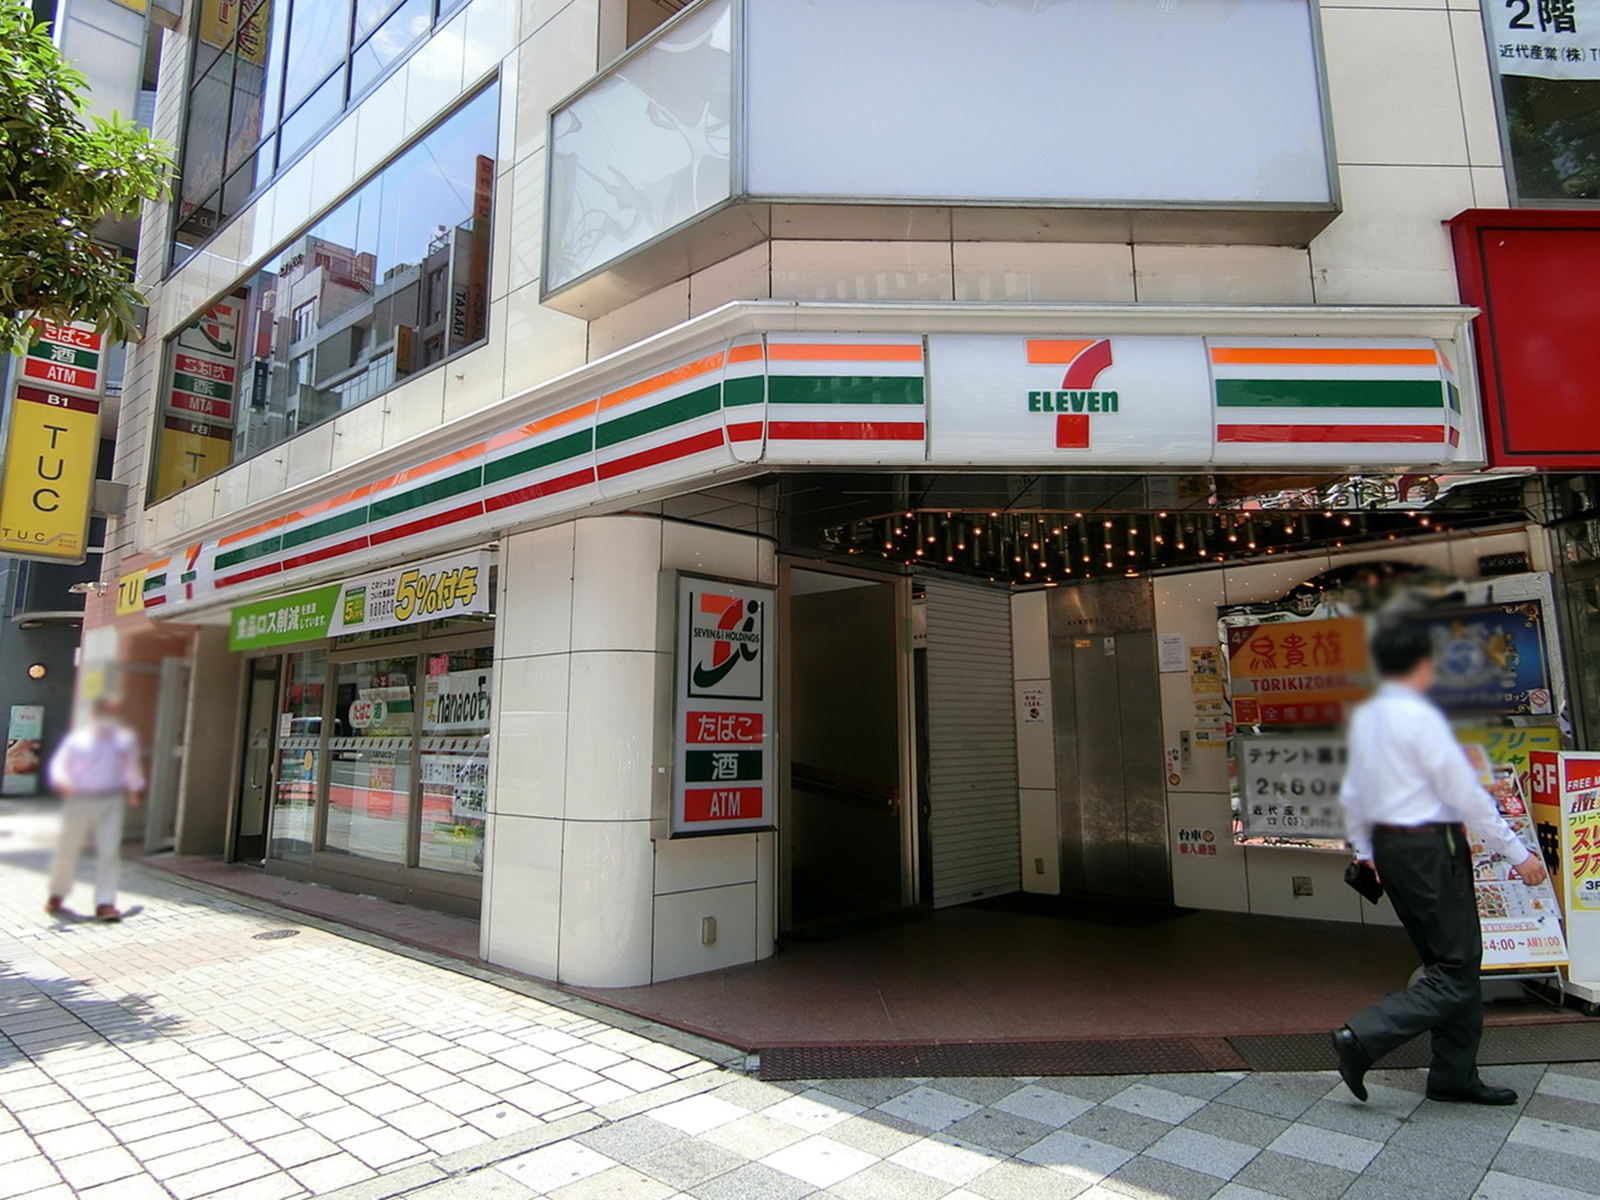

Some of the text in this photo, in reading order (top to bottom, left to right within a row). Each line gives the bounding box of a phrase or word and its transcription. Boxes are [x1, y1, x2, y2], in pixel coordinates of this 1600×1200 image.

[1505, 0, 1577, 33] 2階
[50, 344, 77, 364] 酒
[47, 365, 77, 385] ATM
[47, 393, 69, 407] B1
[33, 424, 68, 513] TUC
[2, 527, 46, 543] TUC
[118, 579, 144, 609] TU
[395, 566, 478, 622] 5%付与
[725, 631, 760, 643] HOLDINGS
[697, 714, 753, 742] たばこ
[711, 752, 739, 781] 酒
[1248, 746, 1348, 765] テナント
[1532, 762, 1557, 794] 3F
[1567, 777, 1591, 791] FREE
[709, 791, 741, 818] ATM
